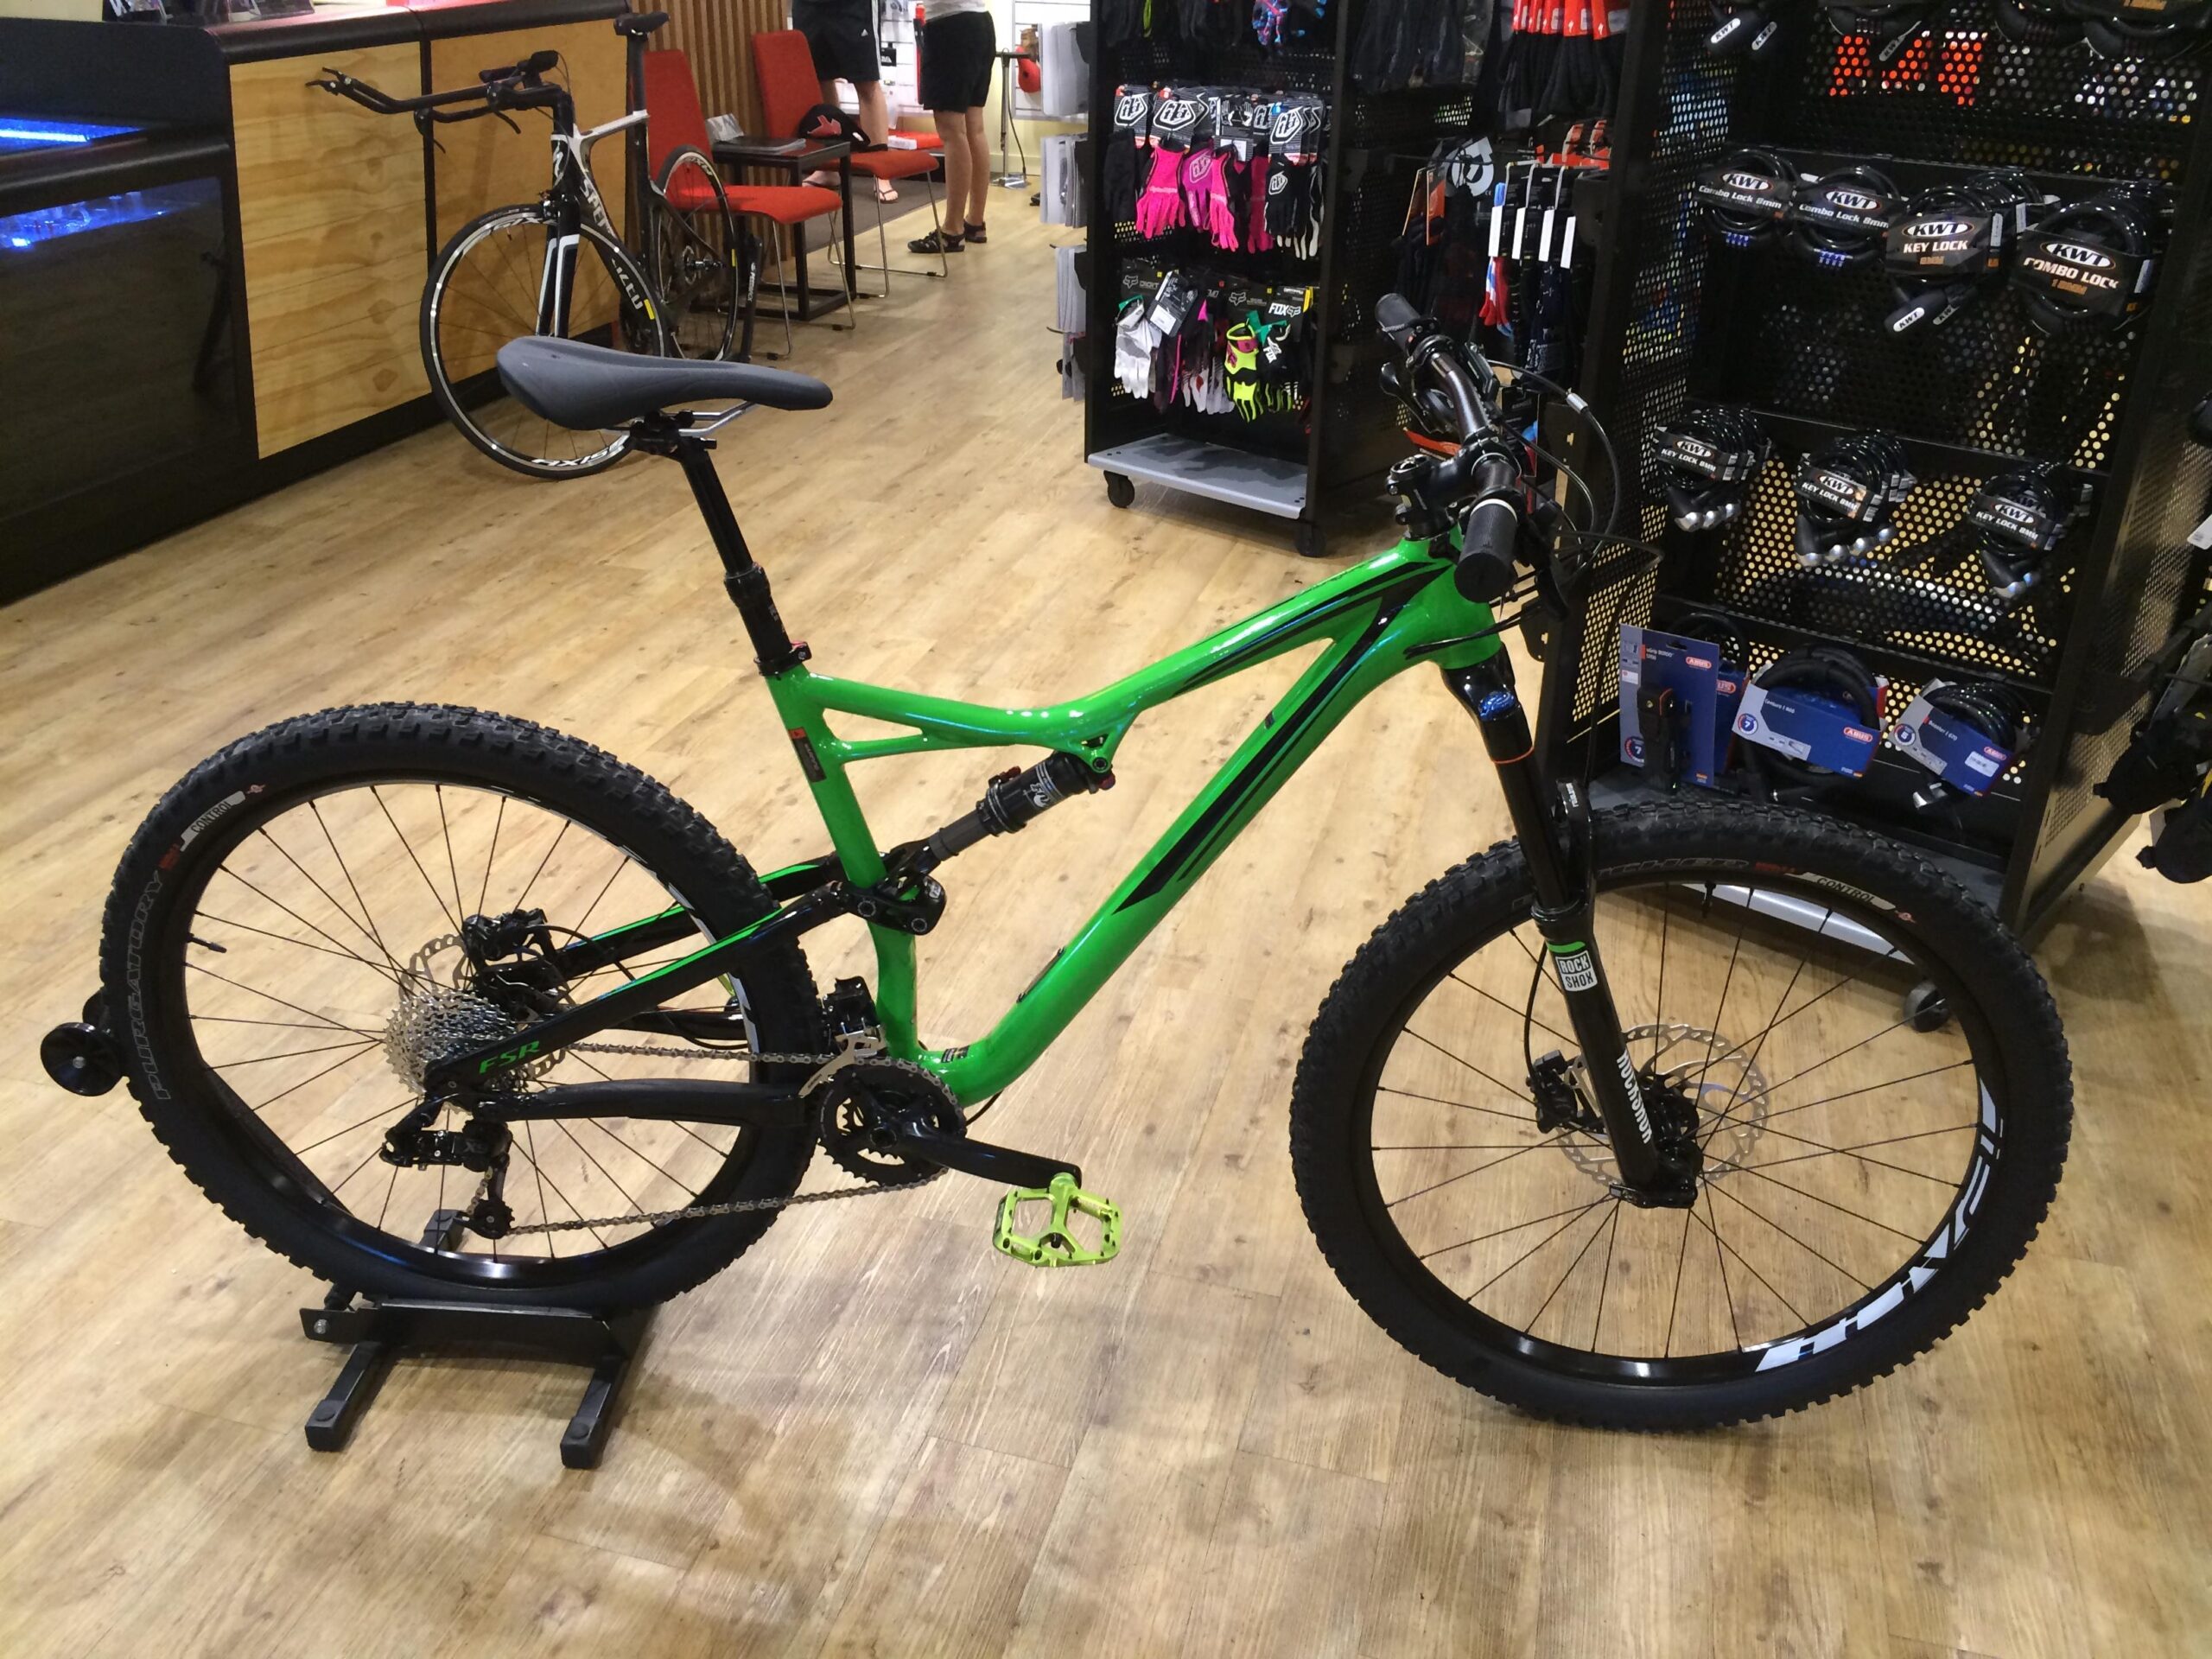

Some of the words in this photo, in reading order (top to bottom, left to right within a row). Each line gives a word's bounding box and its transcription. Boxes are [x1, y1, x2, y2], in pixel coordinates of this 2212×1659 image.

[1728, 174, 1763, 190] KWT
[1699, 185, 1730, 199] Combo
[1731, 191, 1753, 203] Lock
[1832, 191, 1871, 209] KWT
[1799, 203, 1833, 217] Combo
[1836, 210, 1859, 223] Lock
[1913, 223, 1961, 236] KWT
[1904, 241, 1929, 253] KEY
[1932, 239, 1968, 252] LOCK
[2053, 244, 2107, 266] KWT
[2024, 257, 2080, 280] COMBO
[2081, 270, 2119, 289] LOCK
[1268, 302, 1289, 316] FOX
[1899, 310, 1919, 329] KWT
[1661, 448, 1678, 460] KEY
[1678, 453, 1698, 466] LOCK
[1683, 442, 1711, 458] KWT
[1802, 482, 1819, 494] KEY
[1820, 488, 1840, 503] LOCK
[1824, 477, 1851, 494] KWT
[1975, 511, 1993, 522] KEY
[1995, 518, 2018, 531] LOCK
[1999, 505, 2031, 522] KWT
[1817, 876, 1876, 903] CONTROL
[1559, 956, 1589, 975] ROCK
[1565, 971, 1594, 988] SHOX
[478, 1039, 541, 1075] FSR
